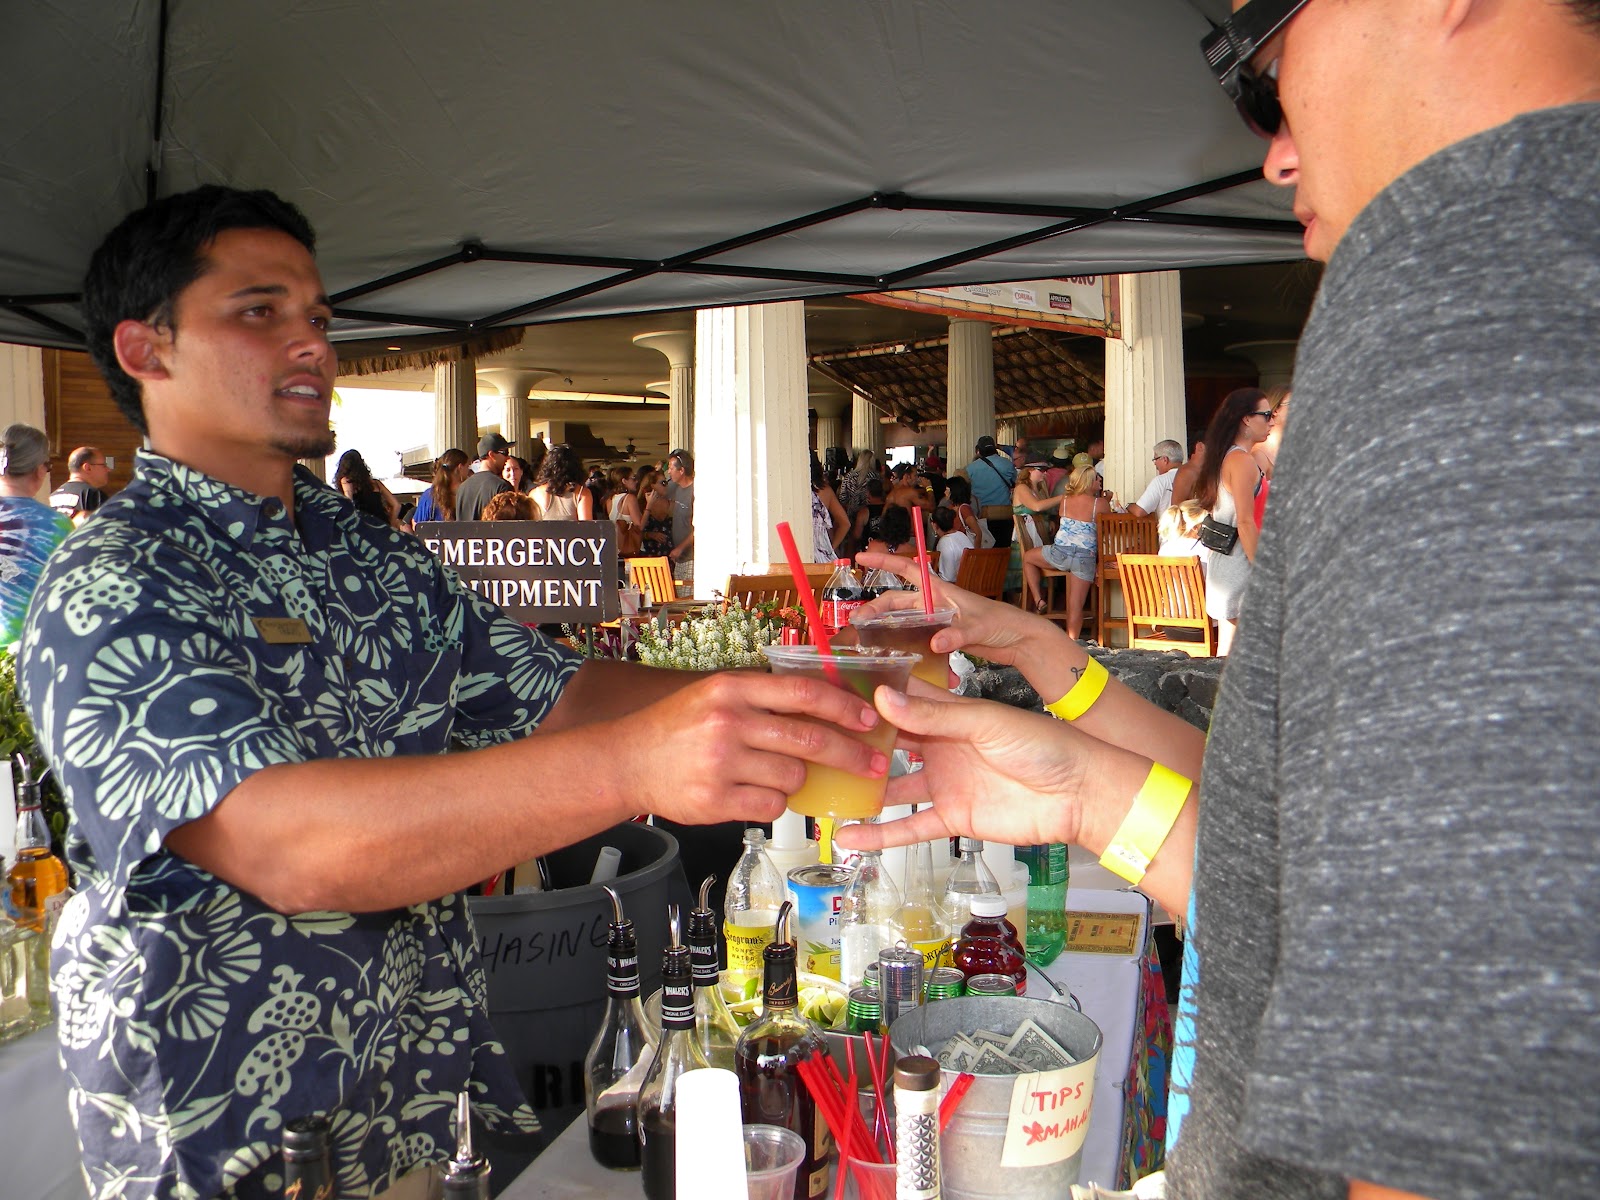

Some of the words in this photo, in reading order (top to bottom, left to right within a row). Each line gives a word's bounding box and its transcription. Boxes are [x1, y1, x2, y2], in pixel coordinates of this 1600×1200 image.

[424, 538, 606, 566] EMERGENCY
[459, 579, 602, 607] UIPMENT
[481, 914, 608, 972] HASING
[726, 930, 764, 945] Seagram's
[664, 985, 690, 997] WHALER'S
[1031, 1081, 1085, 1112] TIPS
